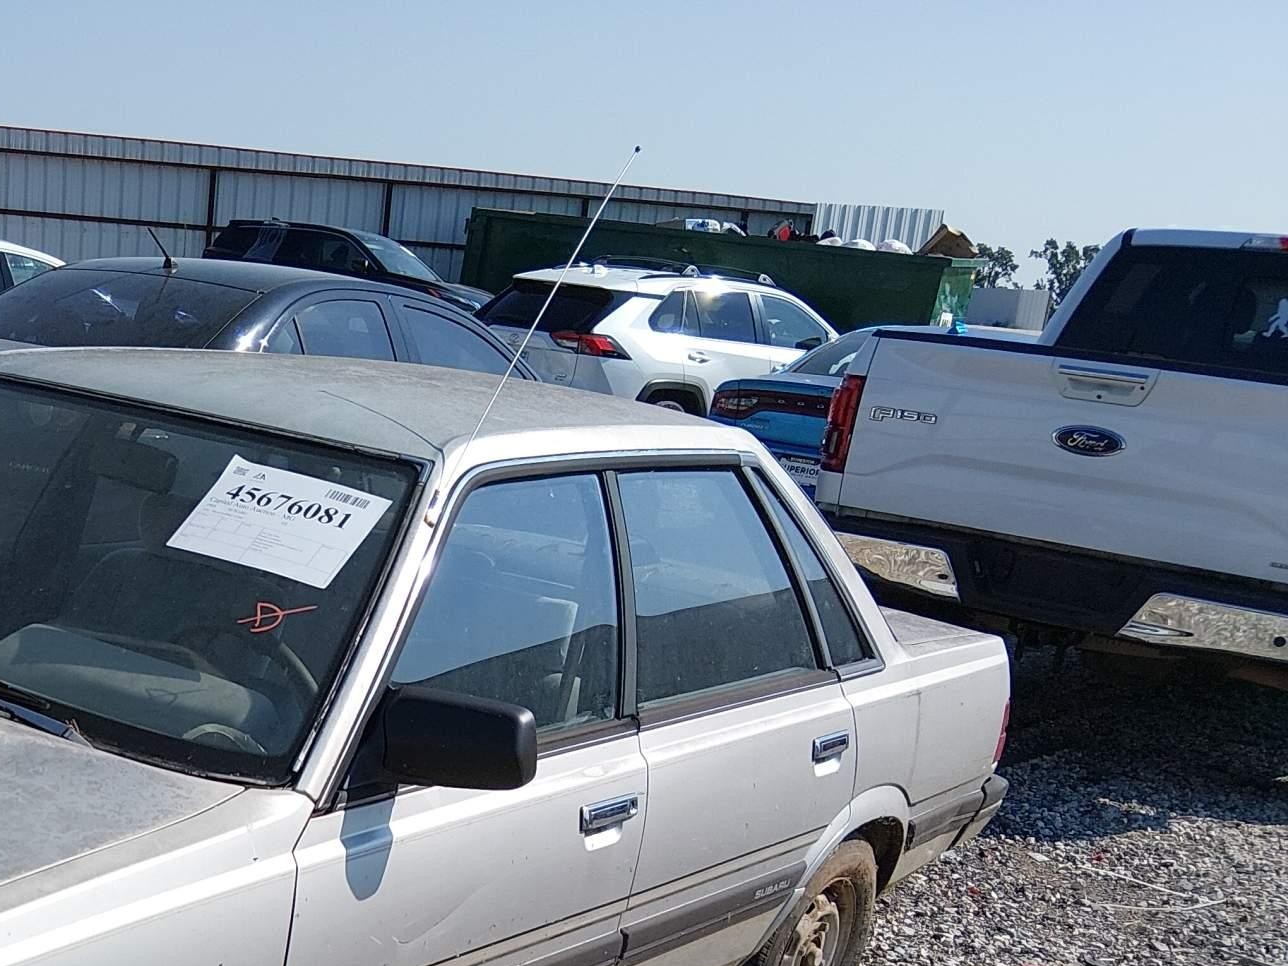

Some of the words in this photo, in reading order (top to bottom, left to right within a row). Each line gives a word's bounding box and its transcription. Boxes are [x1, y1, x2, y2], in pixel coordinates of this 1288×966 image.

[1067, 430, 1109, 451] Ford
[225, 484, 352, 530] 45676081
[753, 878, 792, 900] SUBARU
